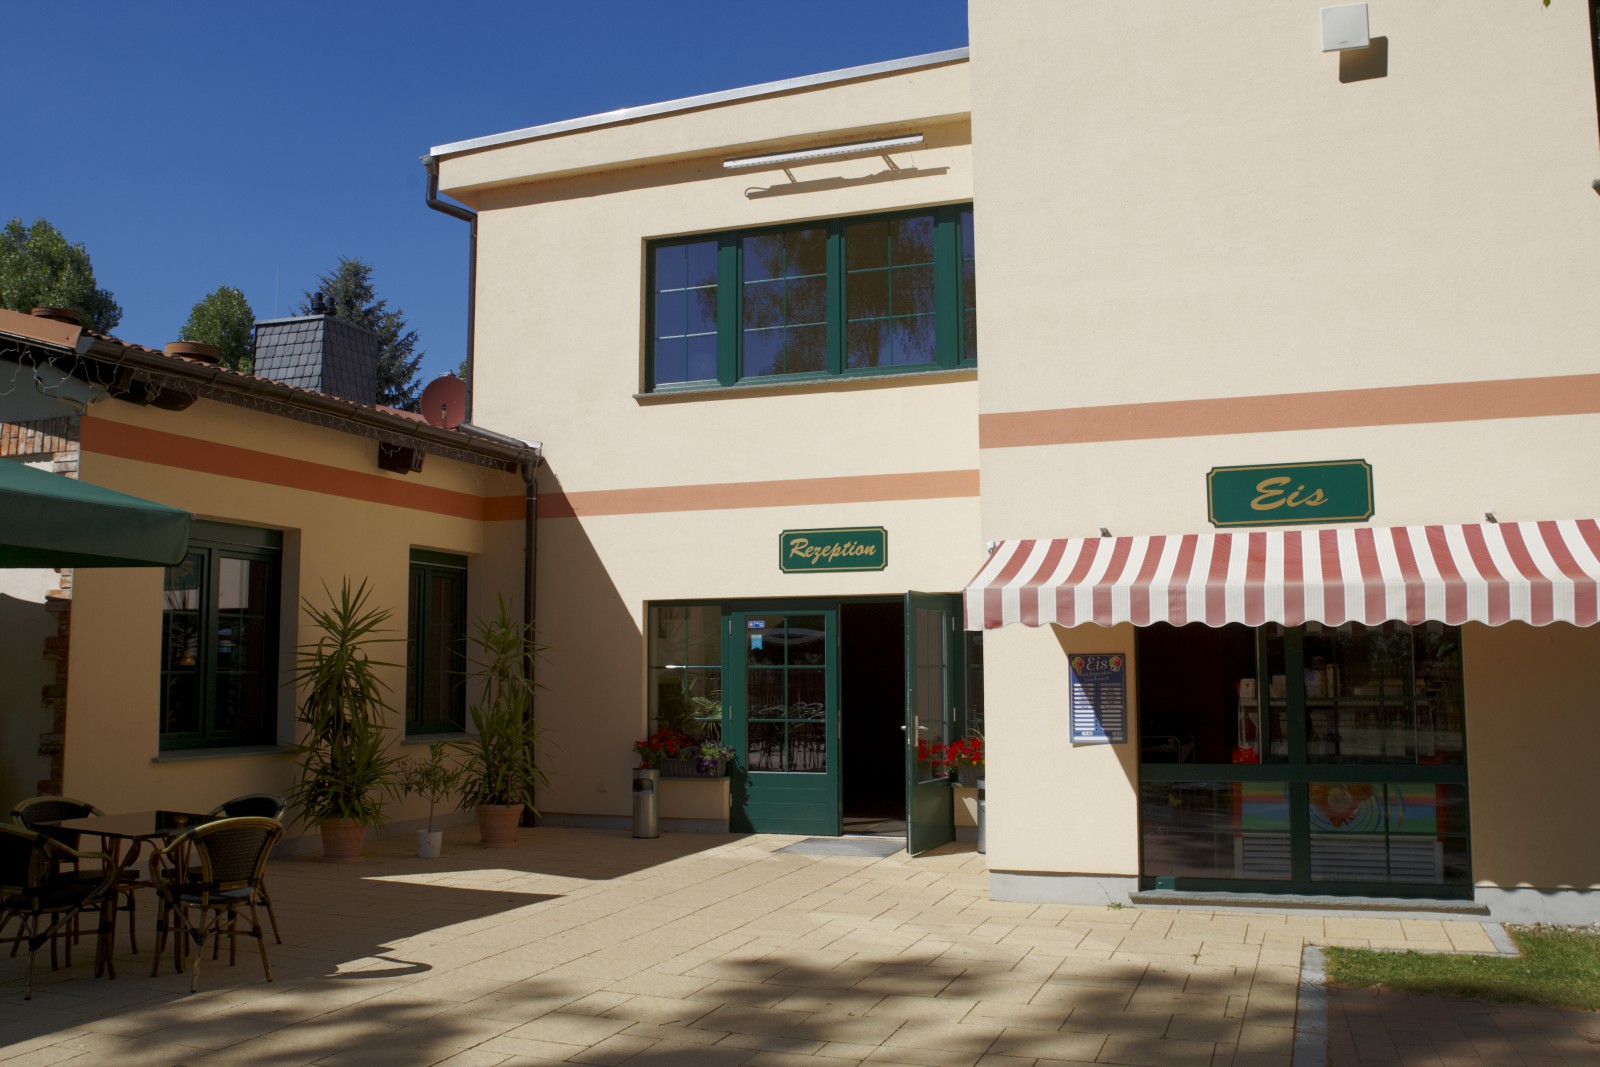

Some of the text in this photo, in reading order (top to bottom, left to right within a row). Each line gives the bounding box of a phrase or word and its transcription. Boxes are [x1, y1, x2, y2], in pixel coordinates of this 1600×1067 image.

[1250, 476, 1328, 511] Eis
[789, 538, 877, 565] Rezeption
[1086, 656, 1108, 671] Eis
